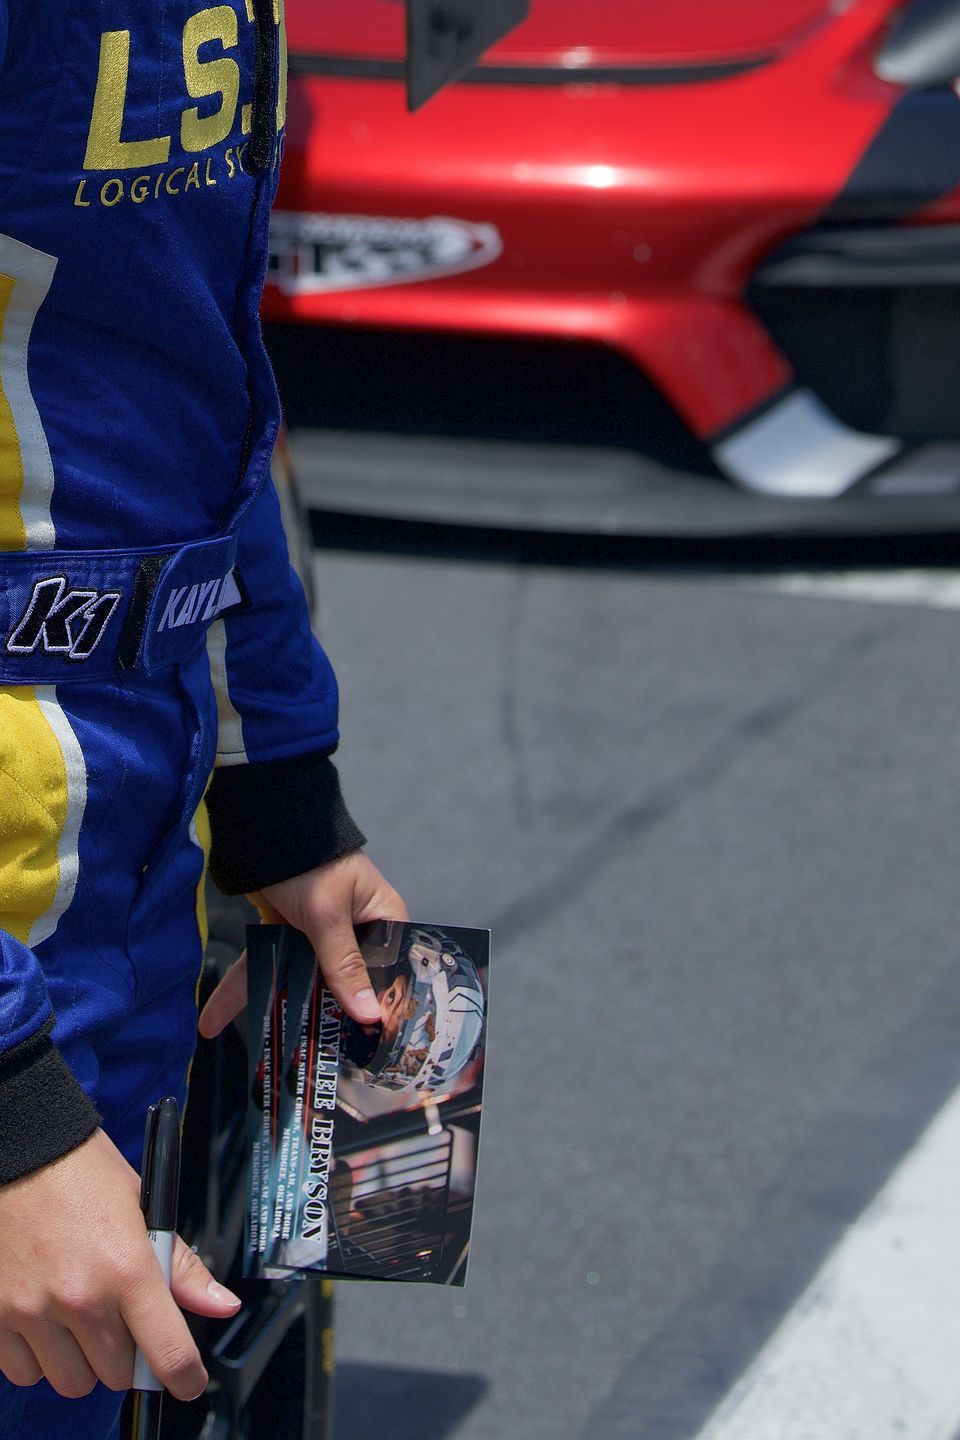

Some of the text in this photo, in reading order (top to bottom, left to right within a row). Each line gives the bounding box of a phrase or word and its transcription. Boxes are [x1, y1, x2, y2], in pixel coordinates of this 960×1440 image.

[74, 158, 217, 207] LOGICAL
[4, 572, 122, 661] K1
[298, 1035, 308, 1060] USAC
[314, 989, 341, 1110] KAYLEE
[262, 1074, 271, 1108] SILVER
[296, 1061, 307, 1095] SILVER
[285, 1191, 295, 1211] AND
[302, 1119, 335, 1243] BRYSON
[271, 1184, 285, 1239] OKLAHOMA
[282, 1213, 293, 1240] MORE
